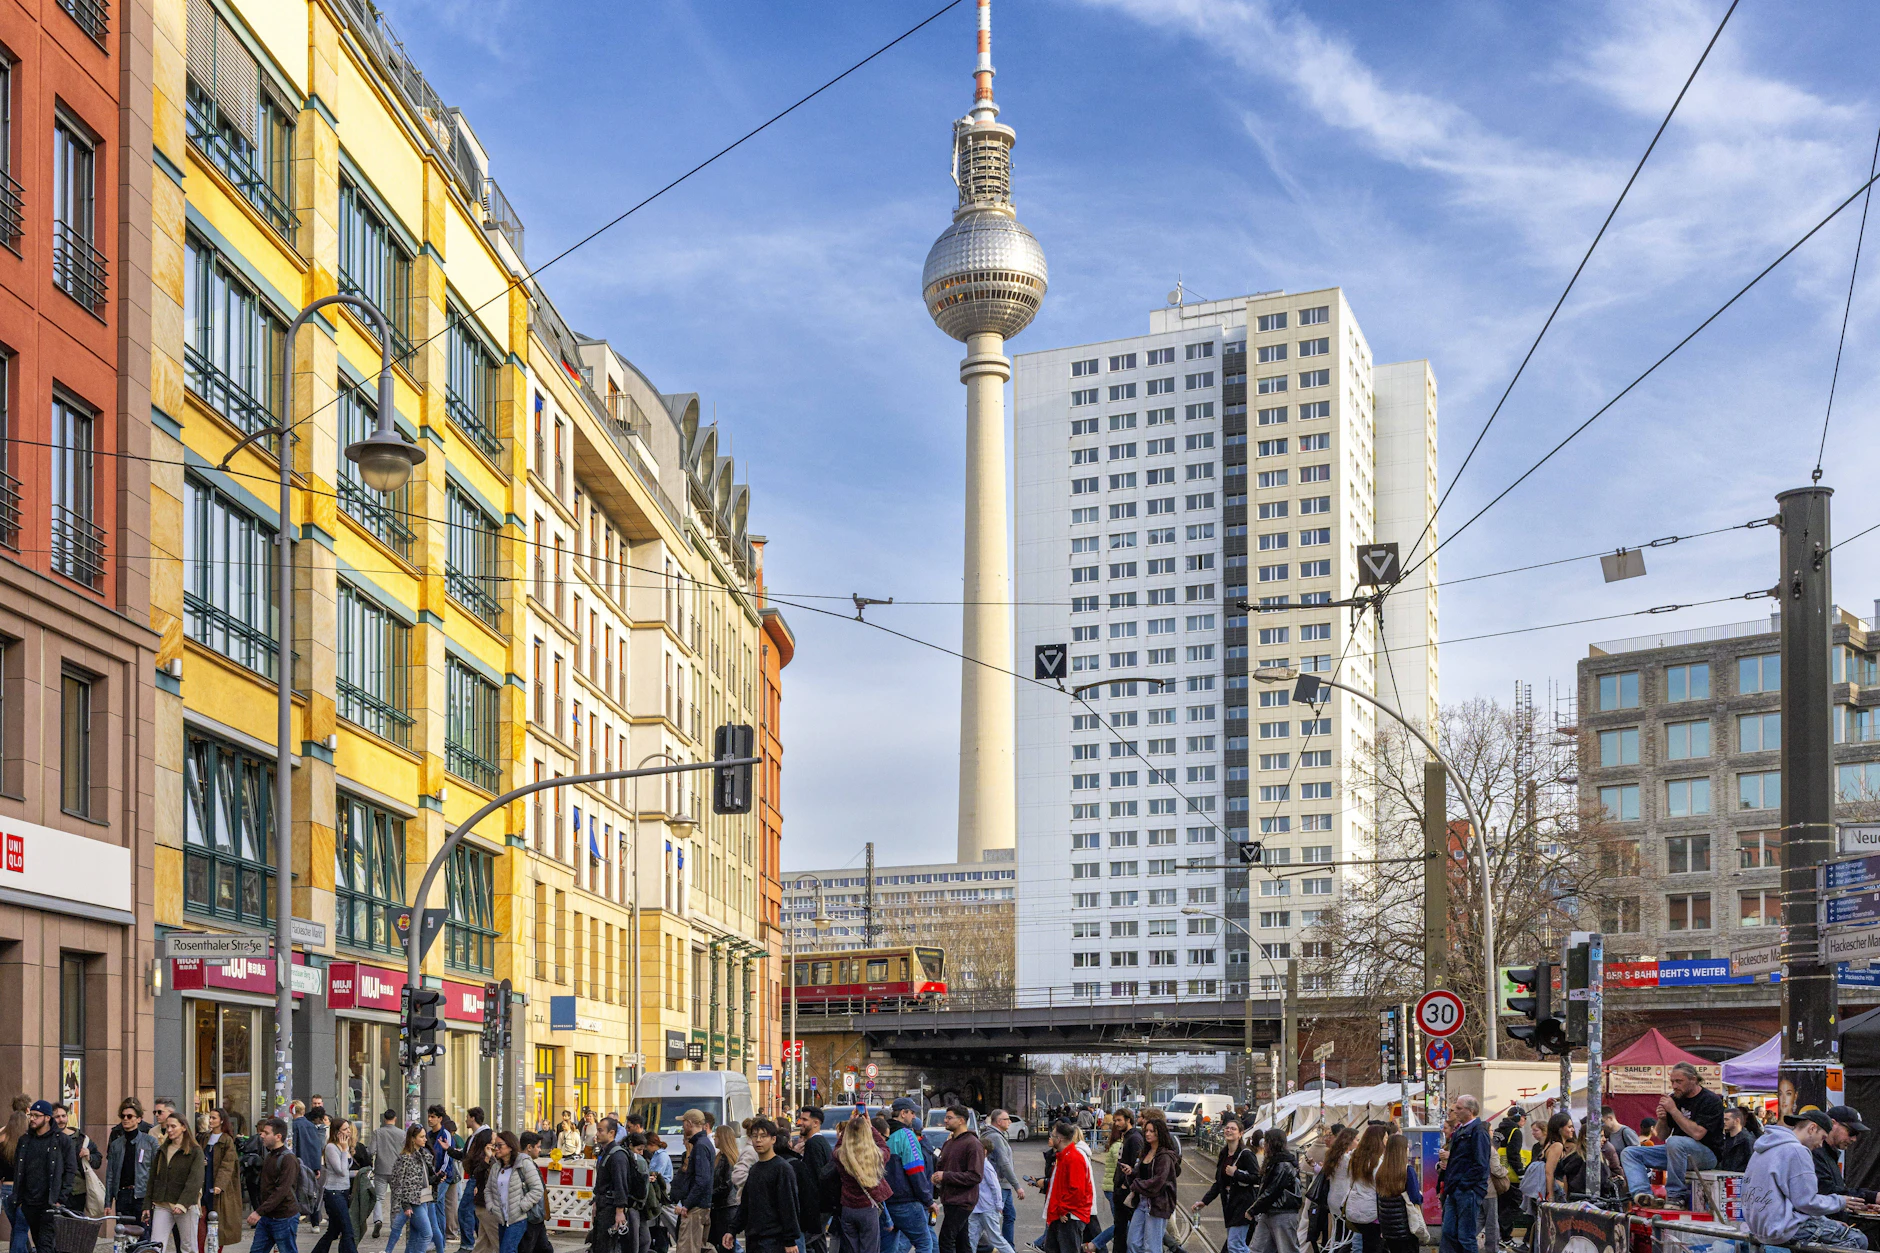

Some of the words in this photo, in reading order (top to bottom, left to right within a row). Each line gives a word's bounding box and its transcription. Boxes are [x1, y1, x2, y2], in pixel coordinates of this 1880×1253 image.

[8, 839, 22, 854] UNI
[8, 854, 22, 868] QLO
[174, 939, 229, 950] Rosenthaler
[231, 940, 262, 953] Straße
[1830, 936, 1866, 953] Hackescher
[1735, 952, 1769, 967] Hackescher
[1770, 948, 1780, 962] Ma
[1625, 970, 1658, 979] S-BAHN
[1660, 968, 1690, 978] GEHT'S
[1692, 967, 1726, 977] WEITER
[332, 980, 352, 989] MUJI
[362, 975, 380, 999] MUJI
[463, 993, 477, 1013] MUJI
[1426, 1004, 1454, 1024] 30
